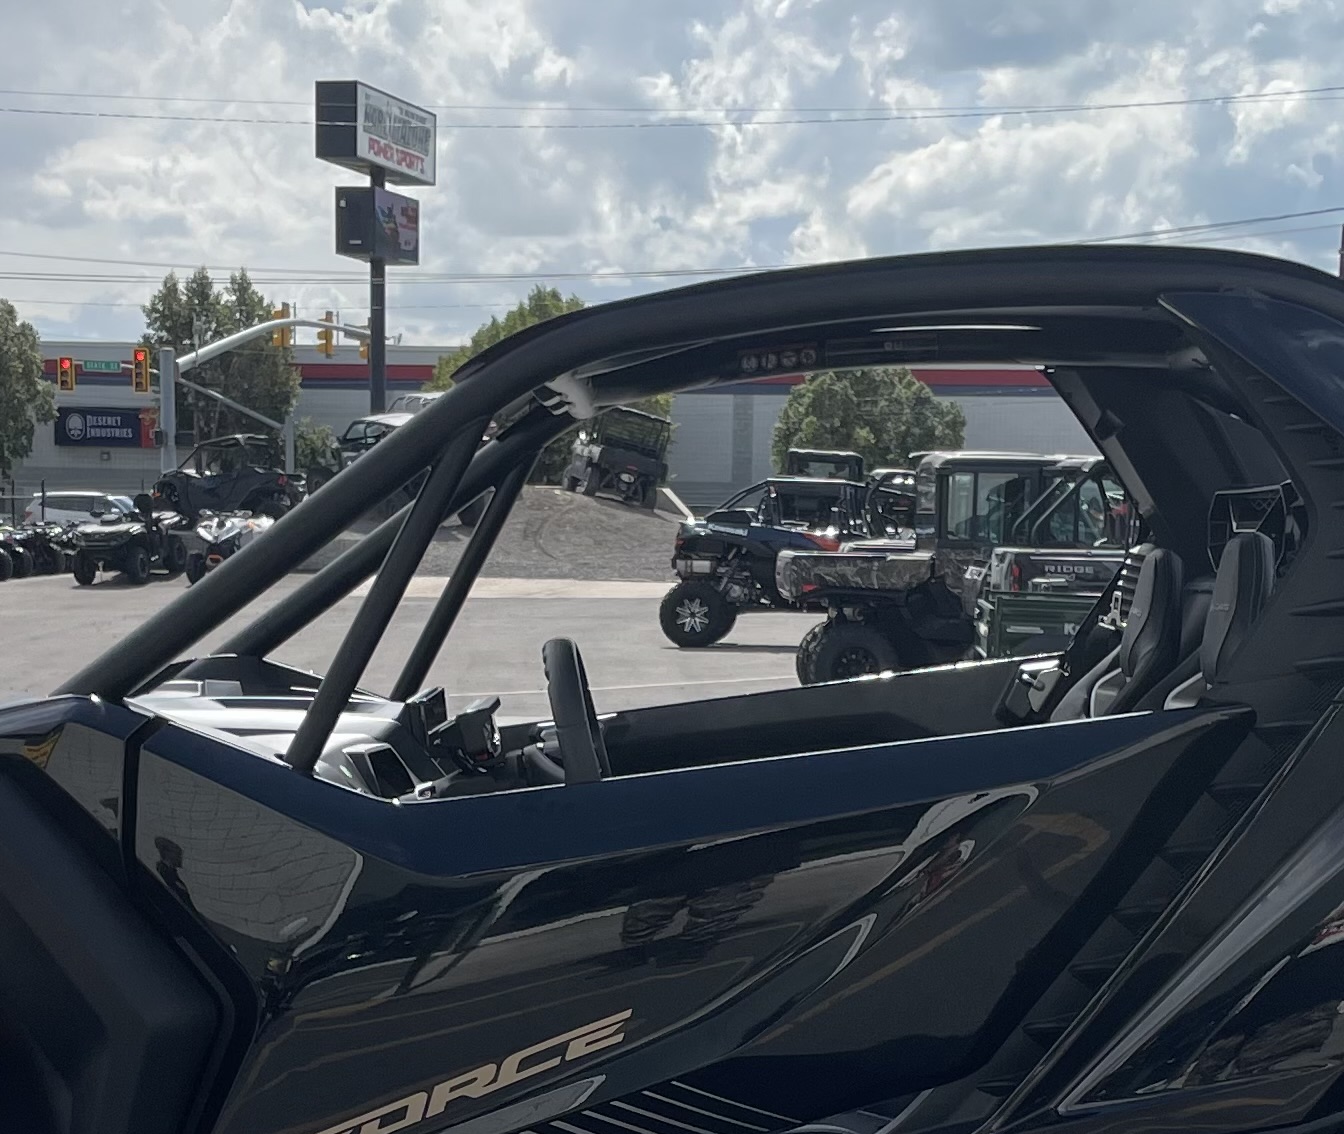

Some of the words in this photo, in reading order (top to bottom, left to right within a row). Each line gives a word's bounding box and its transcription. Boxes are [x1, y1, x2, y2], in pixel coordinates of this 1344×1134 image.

[86, 414, 122, 427] DESERET
[86, 427, 133, 439] INDUSTRIES
[1045, 565, 1094, 574] RIDGE
